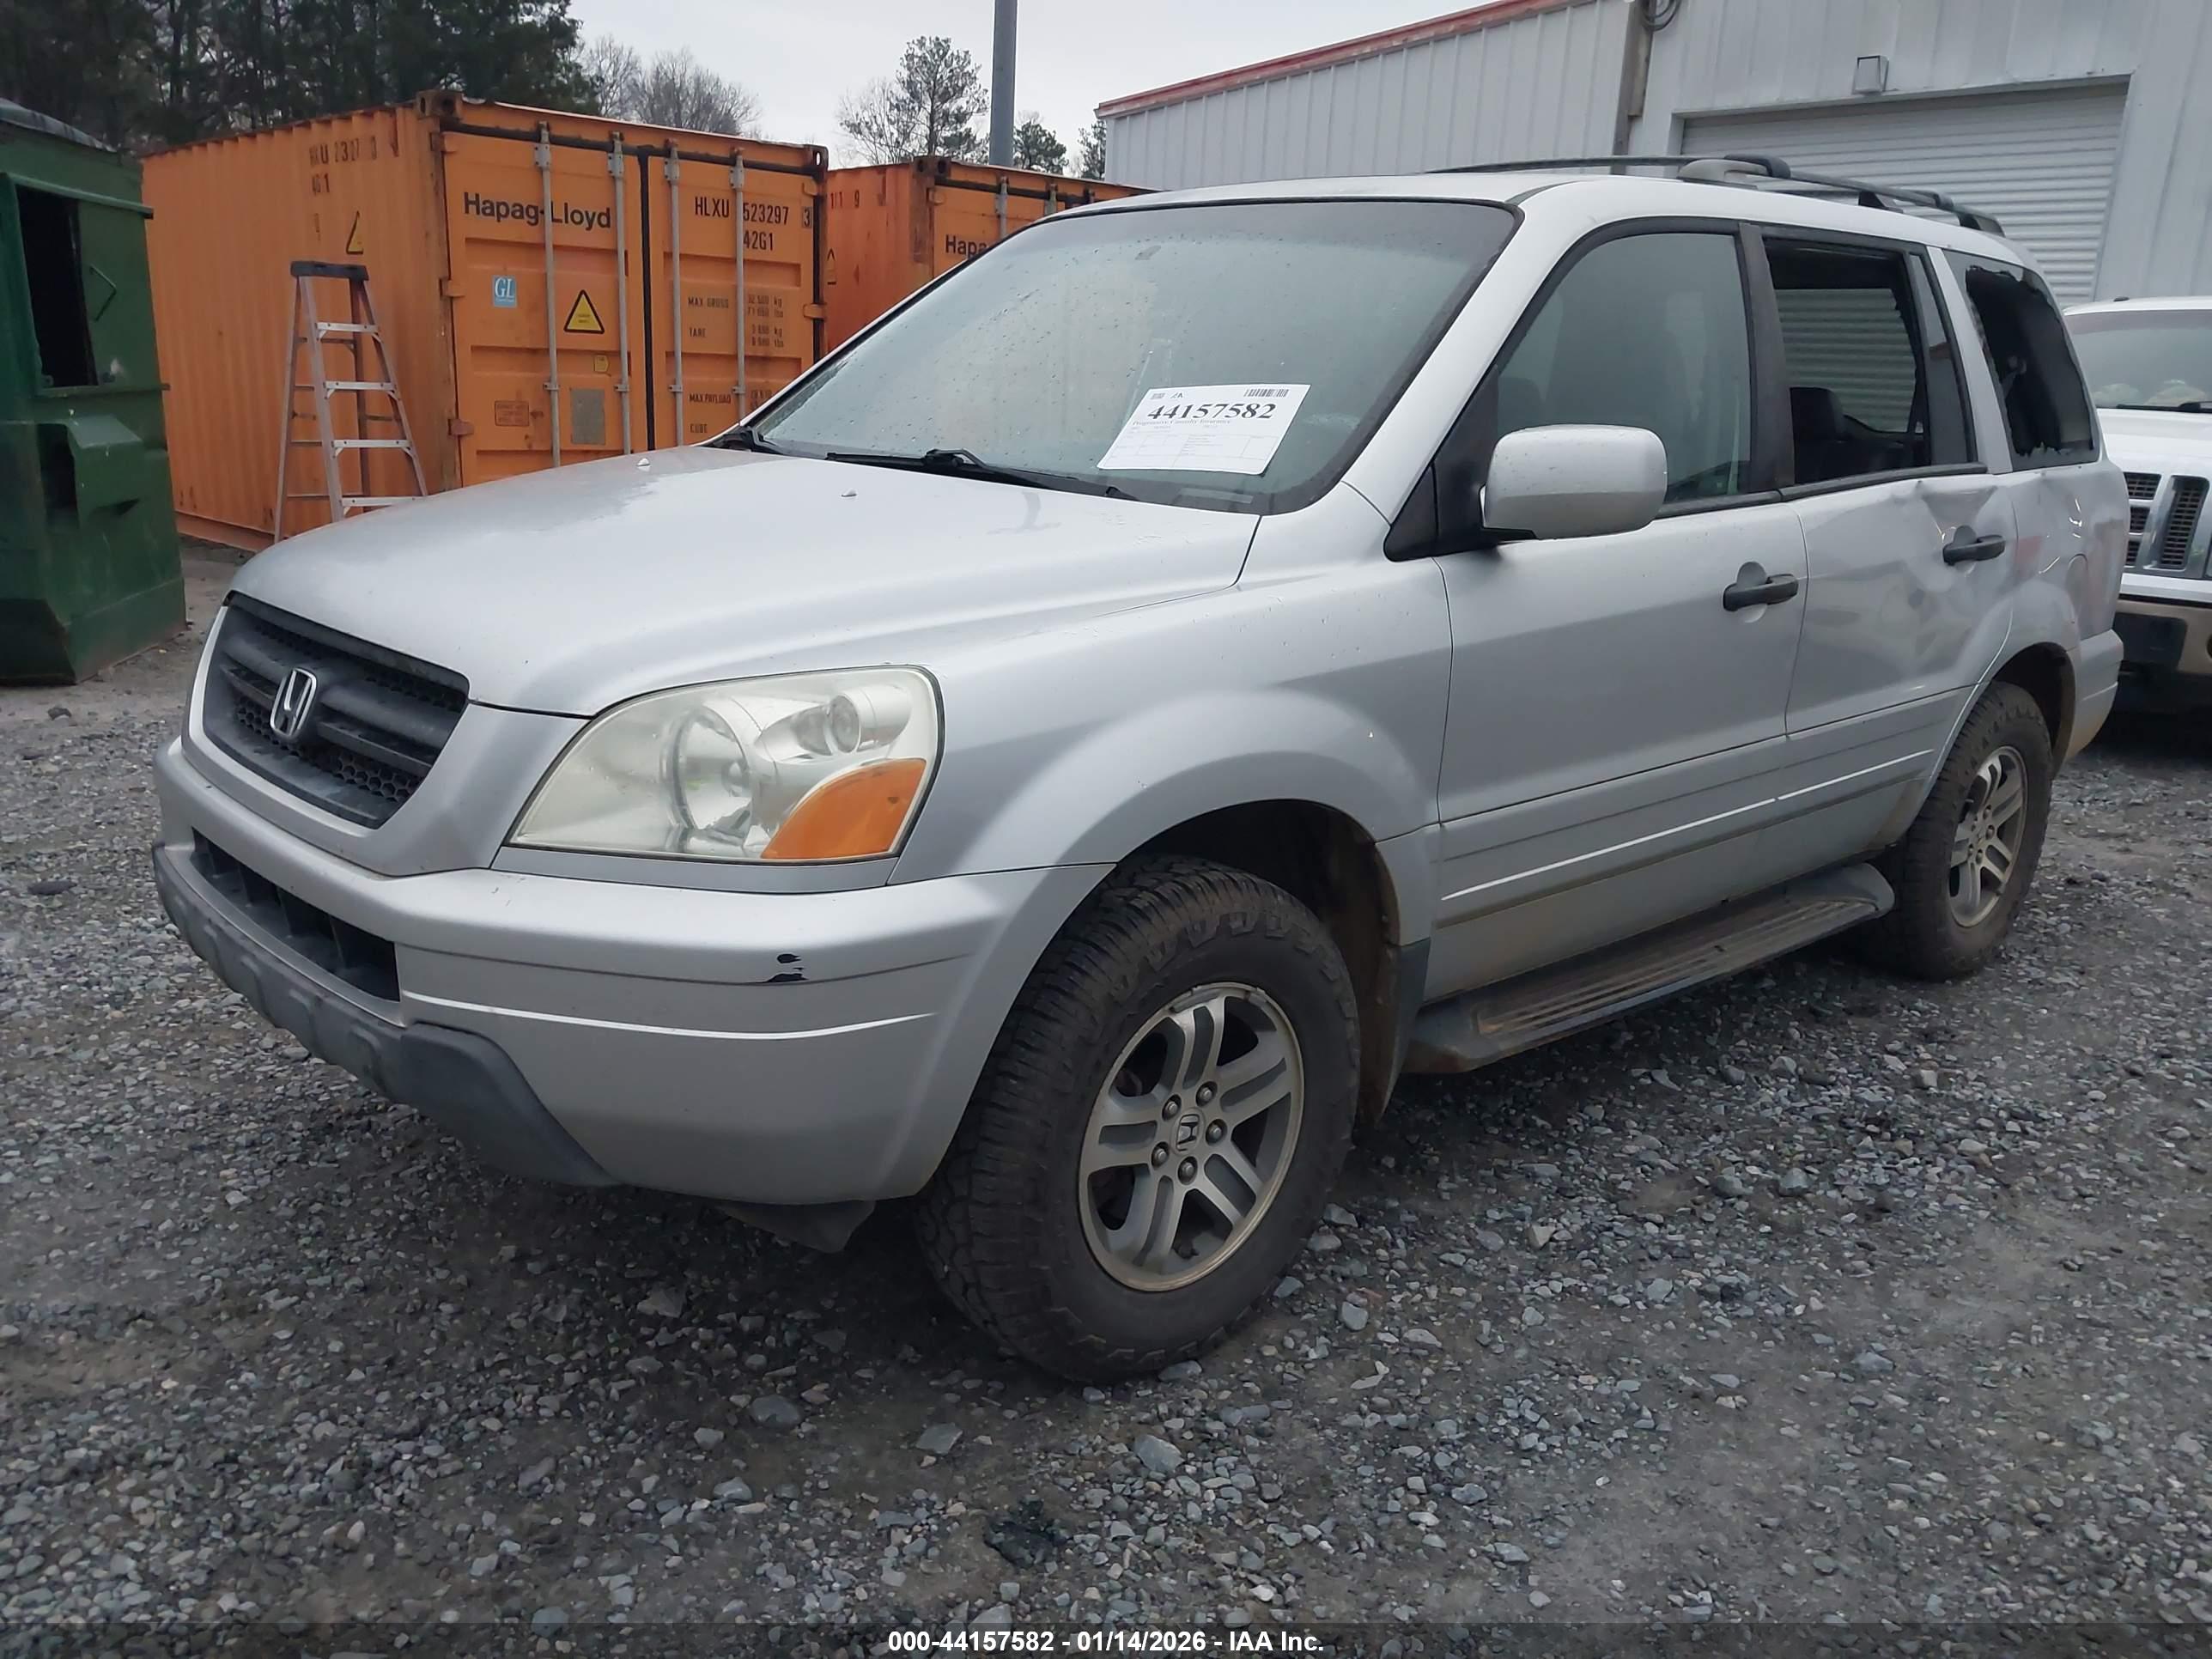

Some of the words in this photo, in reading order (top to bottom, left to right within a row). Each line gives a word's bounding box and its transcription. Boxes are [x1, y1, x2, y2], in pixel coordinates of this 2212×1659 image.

[464, 191, 611, 231] Hapag-Lloyd
[695, 197, 730, 218] HLXU
[743, 203, 789, 225] 523297
[803, 209, 811, 228] 3
[743, 230, 774, 251] 42G1
[945, 234, 988, 256] Hapa
[495, 276, 515, 298] GL
[688, 297, 702, 307] MAX
[690, 327, 706, 338] TARE
[690, 393, 703, 404] MAX
[705, 394, 731, 404] PAYLOAD
[1147, 404, 1276, 419] 44157582
